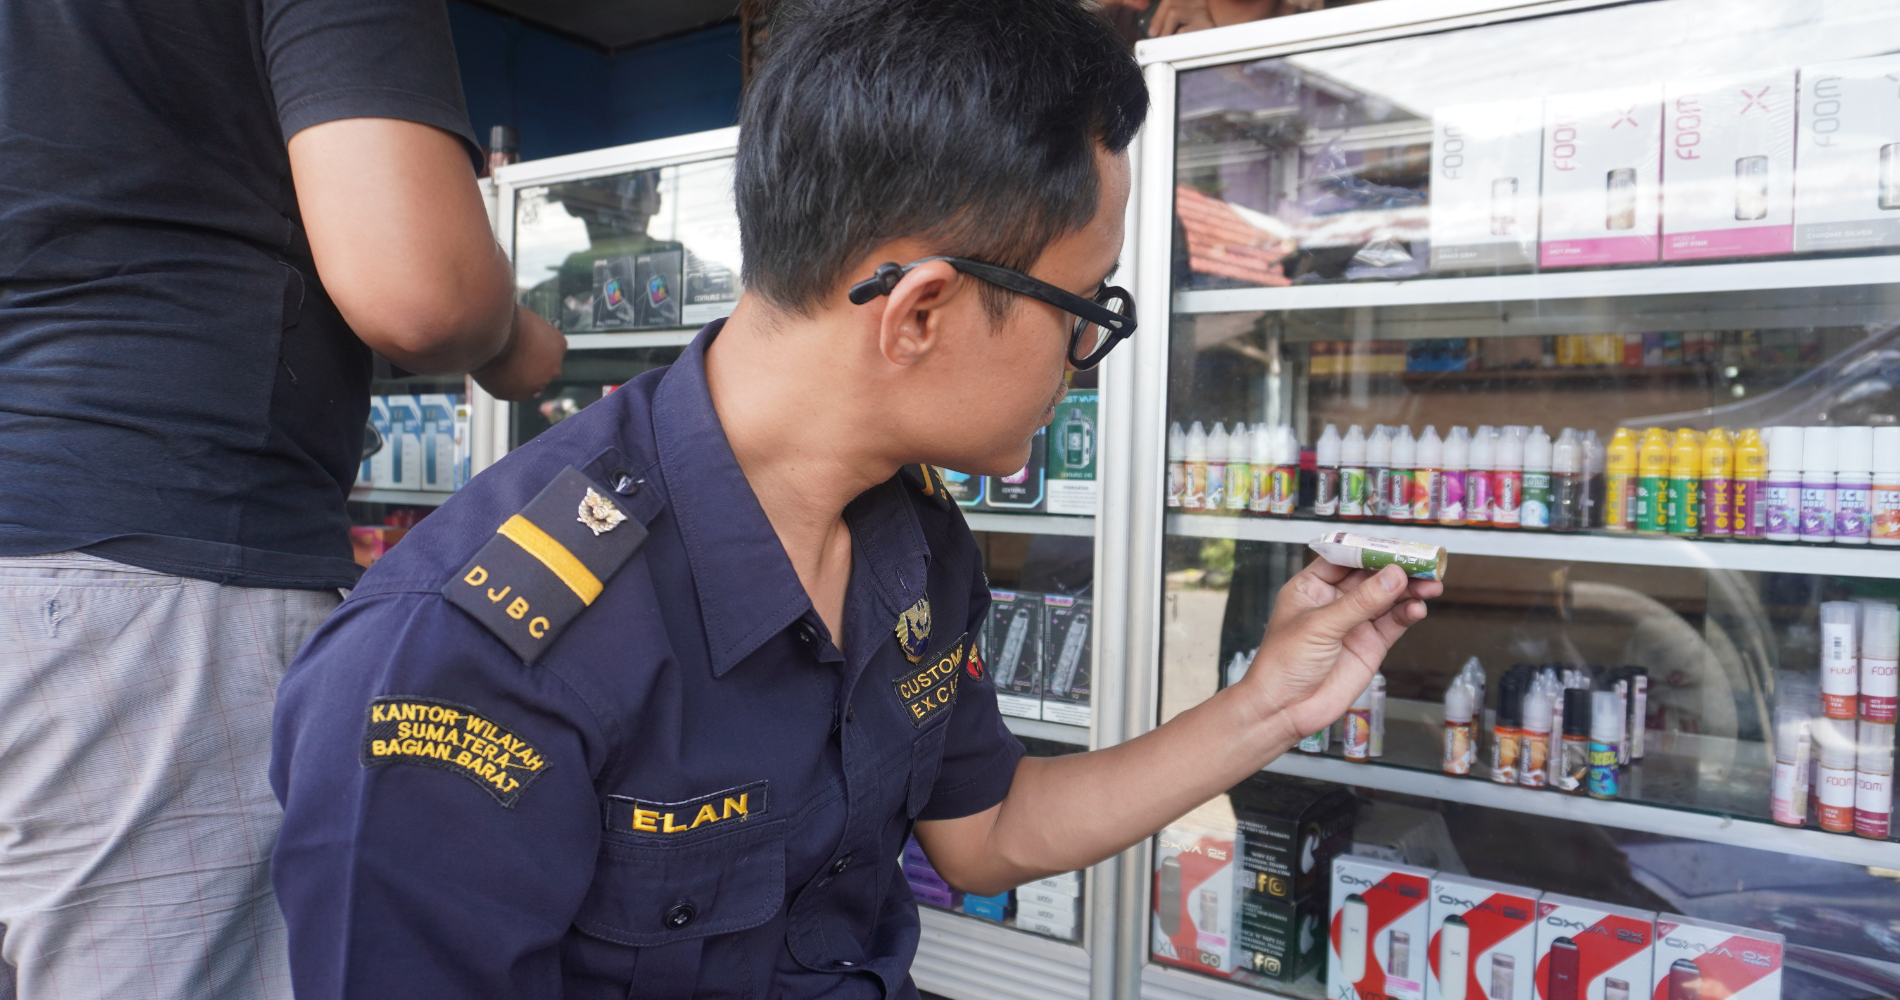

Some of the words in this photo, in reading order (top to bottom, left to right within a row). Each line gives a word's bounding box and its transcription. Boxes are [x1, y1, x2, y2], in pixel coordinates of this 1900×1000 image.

[1811, 76, 1842, 148] FOOM
[1675, 93, 1701, 161] FOOM
[1807, 230, 1843, 239] CHROME
[1844, 229, 1874, 237] SILVER
[1609, 480, 1619, 525] YELO
[1657, 480, 1668, 526] YELO
[1802, 488, 1827, 500] ICE
[1838, 489, 1866, 501] ICE
[1879, 490, 1900, 502] IC
[1686, 482, 1698, 528] YELO
[1714, 482, 1728, 528] YELO
[1735, 483, 1746, 530] YELO
[463, 566, 551, 640] DJBC
[1871, 666, 1898, 676] FOOM
[372, 703, 459, 726] KANTOR
[466, 715, 545, 771] WILAYAH
[398, 722, 511, 769] SUMATERA
[372, 739, 453, 761] BAGIAN
[456, 750, 520, 793] BARAT
[1826, 776, 1854, 787] FOOM
[632, 793, 748, 834] ELAN
[1159, 839, 1202, 855] OXVA
[1269, 861, 1288, 870] IDAHO
[1340, 874, 1393, 893] OXVA
[1036, 894, 1053, 904] FOOM
[1438, 894, 1496, 914] OXVA
[1038, 909, 1054, 919] FOOM
[1546, 916, 1609, 936] OXVA
[1617, 928, 1644, 939] OX
[1664, 936, 1733, 958] OXVA
[1742, 950, 1772, 963] OX
[1200, 953, 1220, 967] GO
[1743, 958, 1771, 968] PASSION
